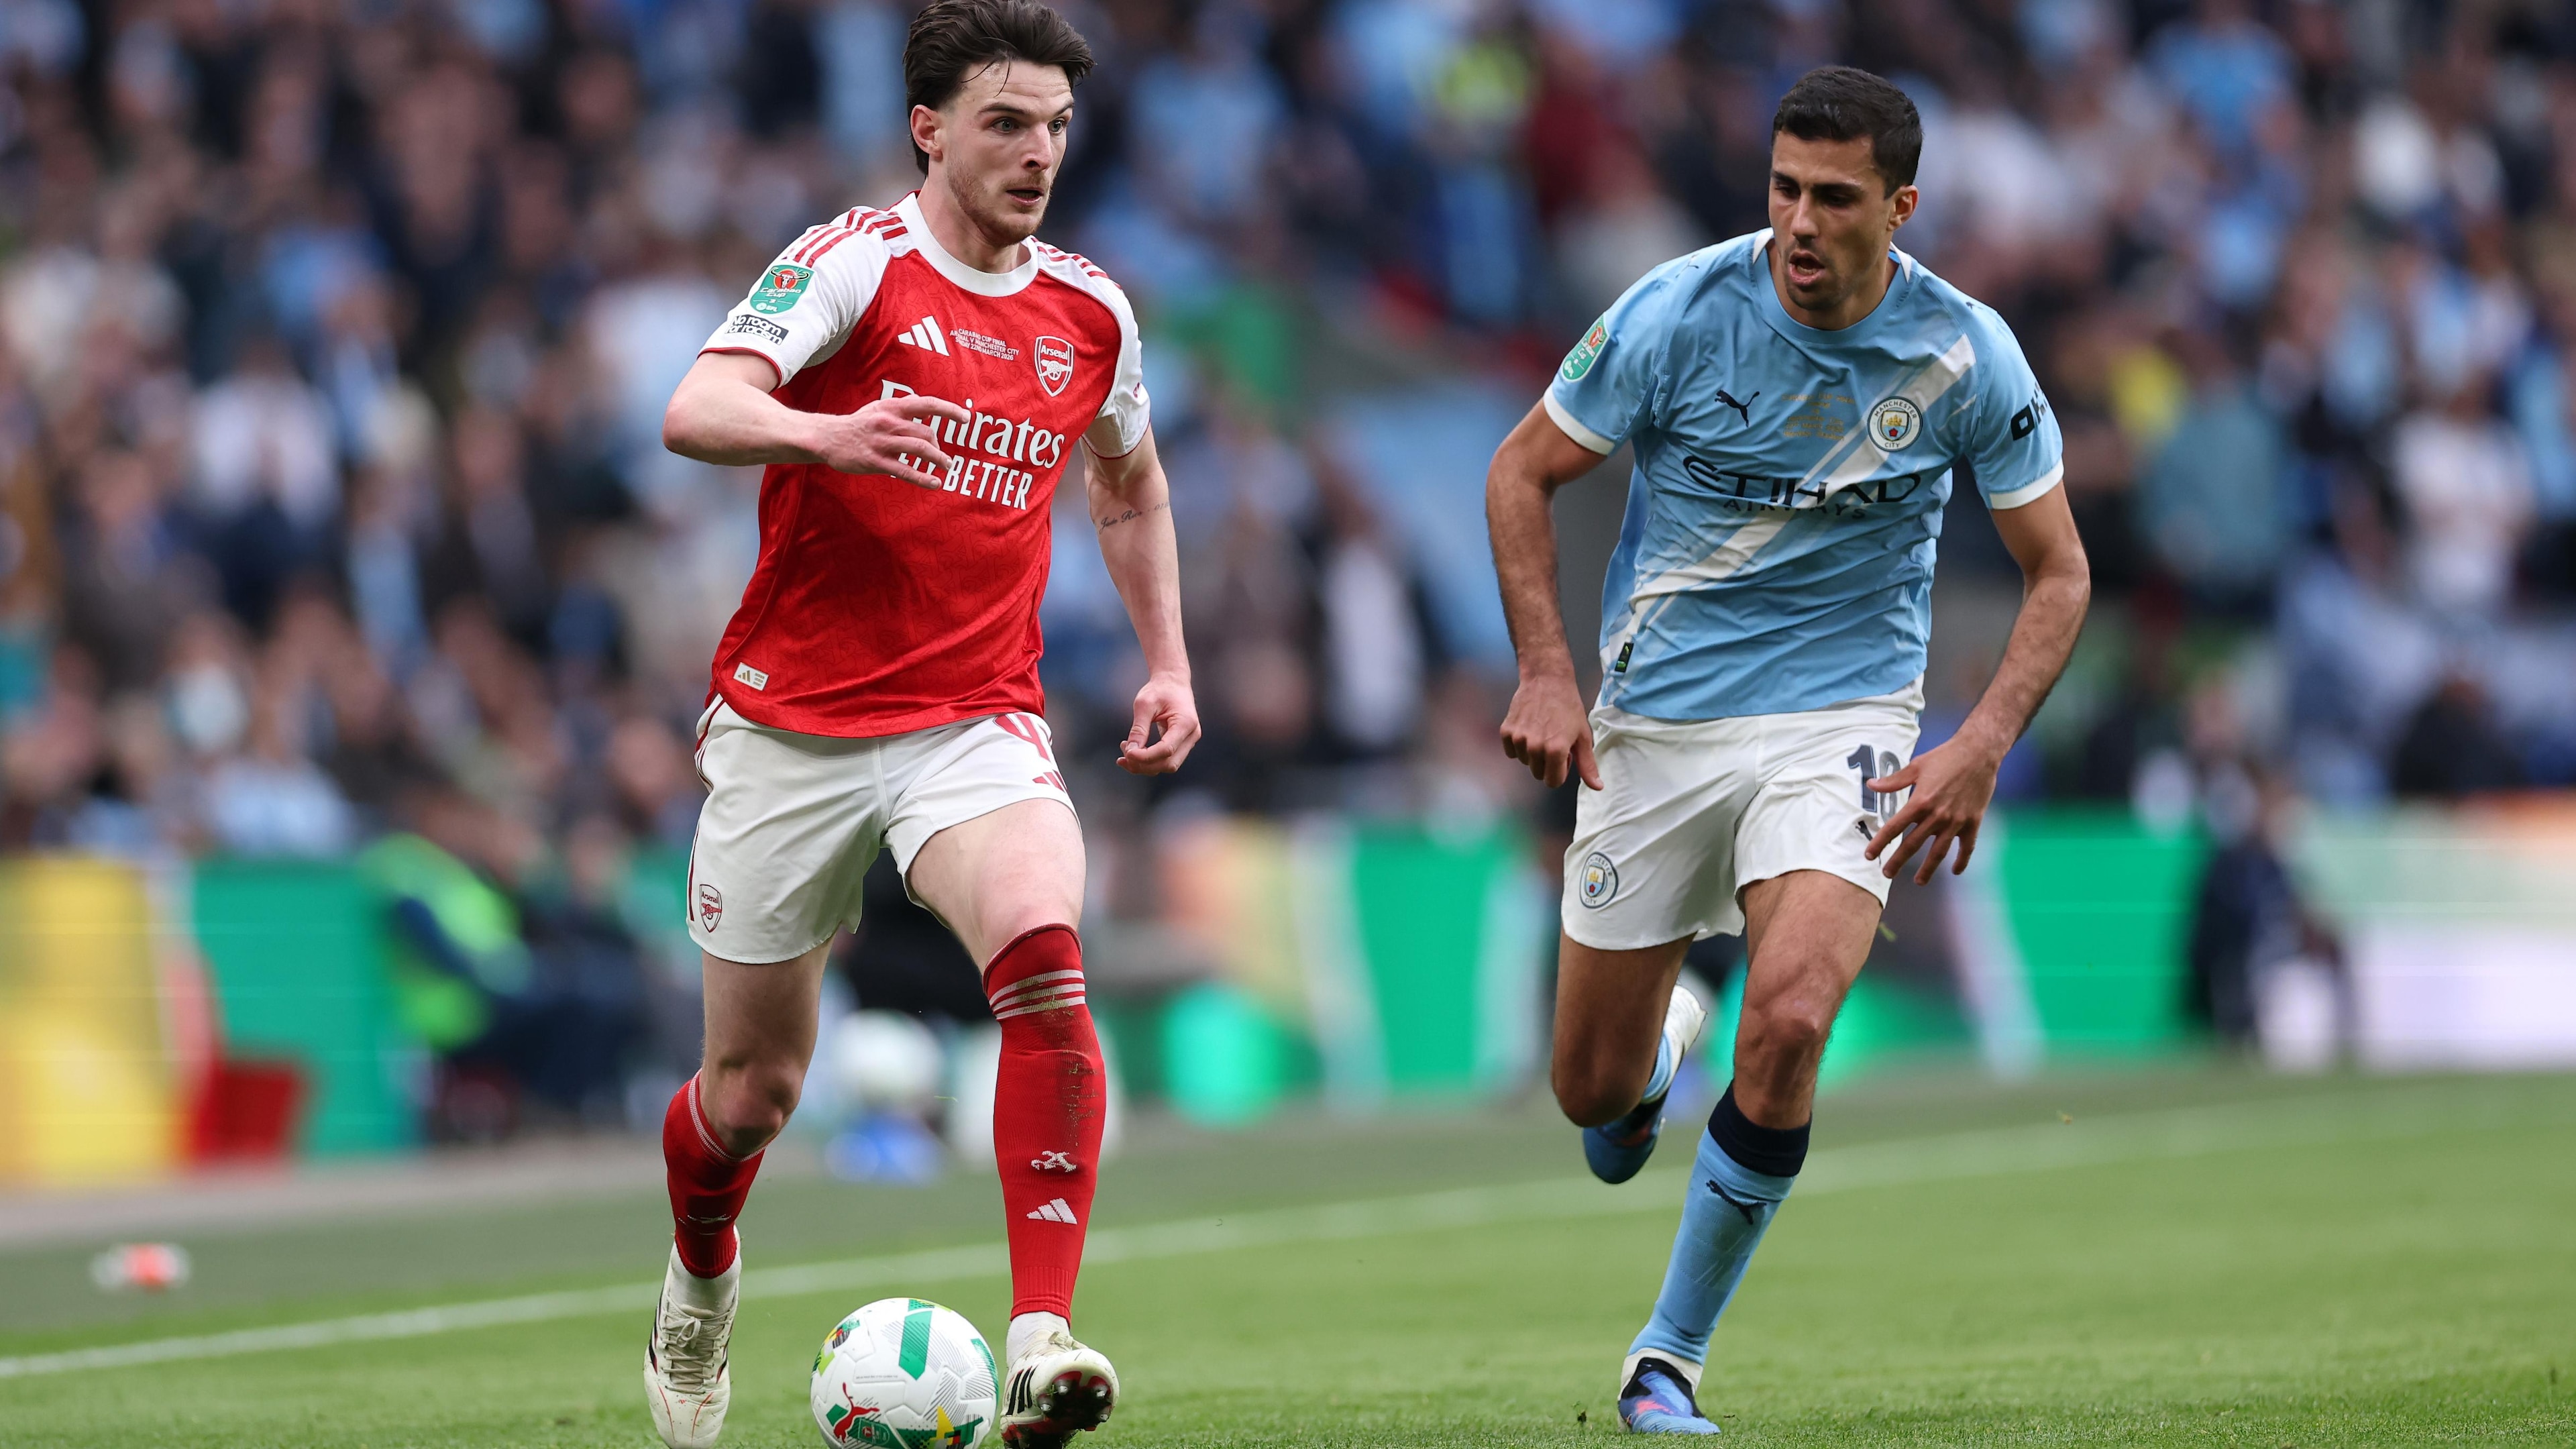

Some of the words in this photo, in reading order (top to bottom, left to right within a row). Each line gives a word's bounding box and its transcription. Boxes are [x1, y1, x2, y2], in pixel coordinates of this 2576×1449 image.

[746, 317, 782, 336] room
[981, 335, 992, 343] CUP
[992, 338, 1006, 347] FINAL
[982, 347, 1001, 358] MARCH
[1000, 352, 1014, 361] 2026
[1007, 347, 1020, 356] CITY
[1040, 344, 1068, 360] Arsenal
[1874, 402, 1918, 420] MANCHESTER
[943, 454, 1034, 511] BETTER
[1723, 498, 1868, 519] AIRAYS
